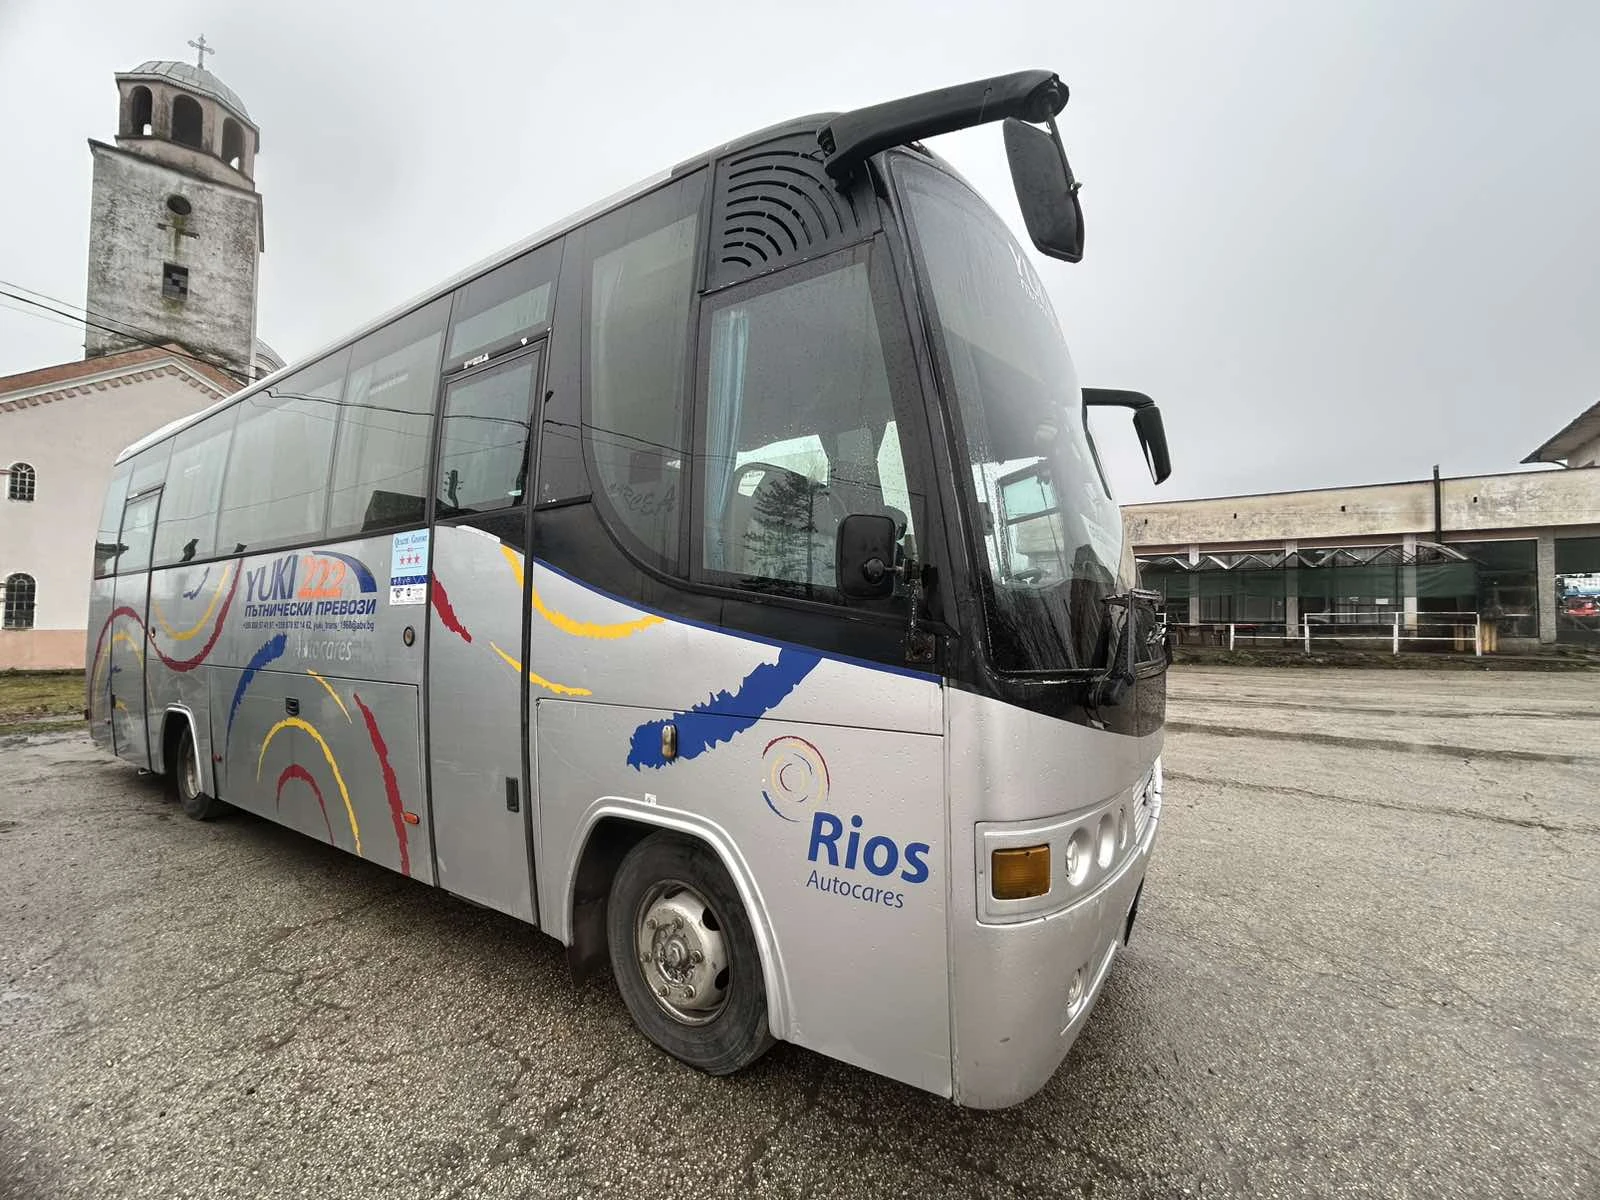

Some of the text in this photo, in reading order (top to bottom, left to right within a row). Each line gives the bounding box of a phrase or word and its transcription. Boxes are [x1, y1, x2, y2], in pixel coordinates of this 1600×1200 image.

[246, 554, 347, 602] YUKI 222
[245, 598, 377, 617] ПЪТНИЧЕСКИ ПРЕВОЗИ
[807, 811, 930, 884] Rios
[806, 869, 904, 909] Autocares
